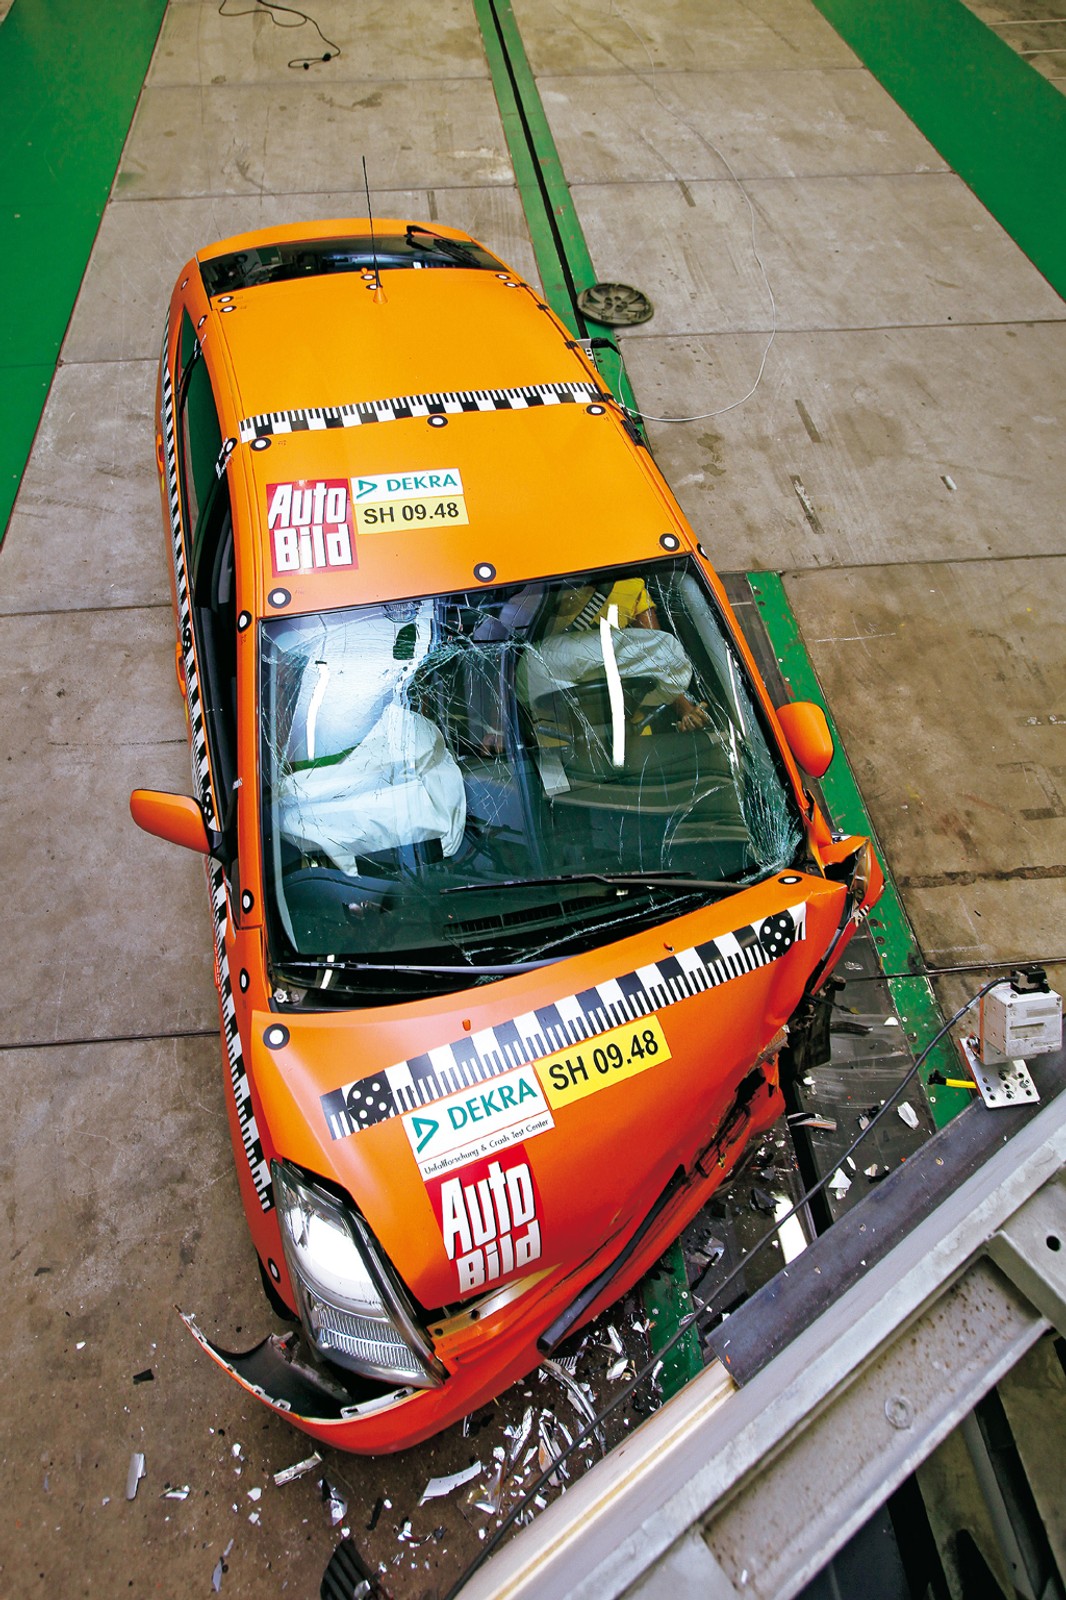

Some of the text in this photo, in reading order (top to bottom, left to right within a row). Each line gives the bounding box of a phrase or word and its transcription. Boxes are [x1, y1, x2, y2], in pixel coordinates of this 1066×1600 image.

[268, 482, 347, 530] Auto
[386, 473, 458, 492] DEKRA
[363, 502, 459, 524] SH 09.48
[274, 523, 353, 572] Bild
[548, 1029, 659, 1091] SH 09.48
[447, 1077, 538, 1130] DEKRA
[424, 1148, 480, 1175] Unfallforschung
[489, 1134, 510, 1148] Crash
[511, 1129, 524, 1139] Test
[525, 1119, 549, 1133] Center
[440, 1161, 536, 1260] Auto
[456, 1219, 542, 1294] Bild
